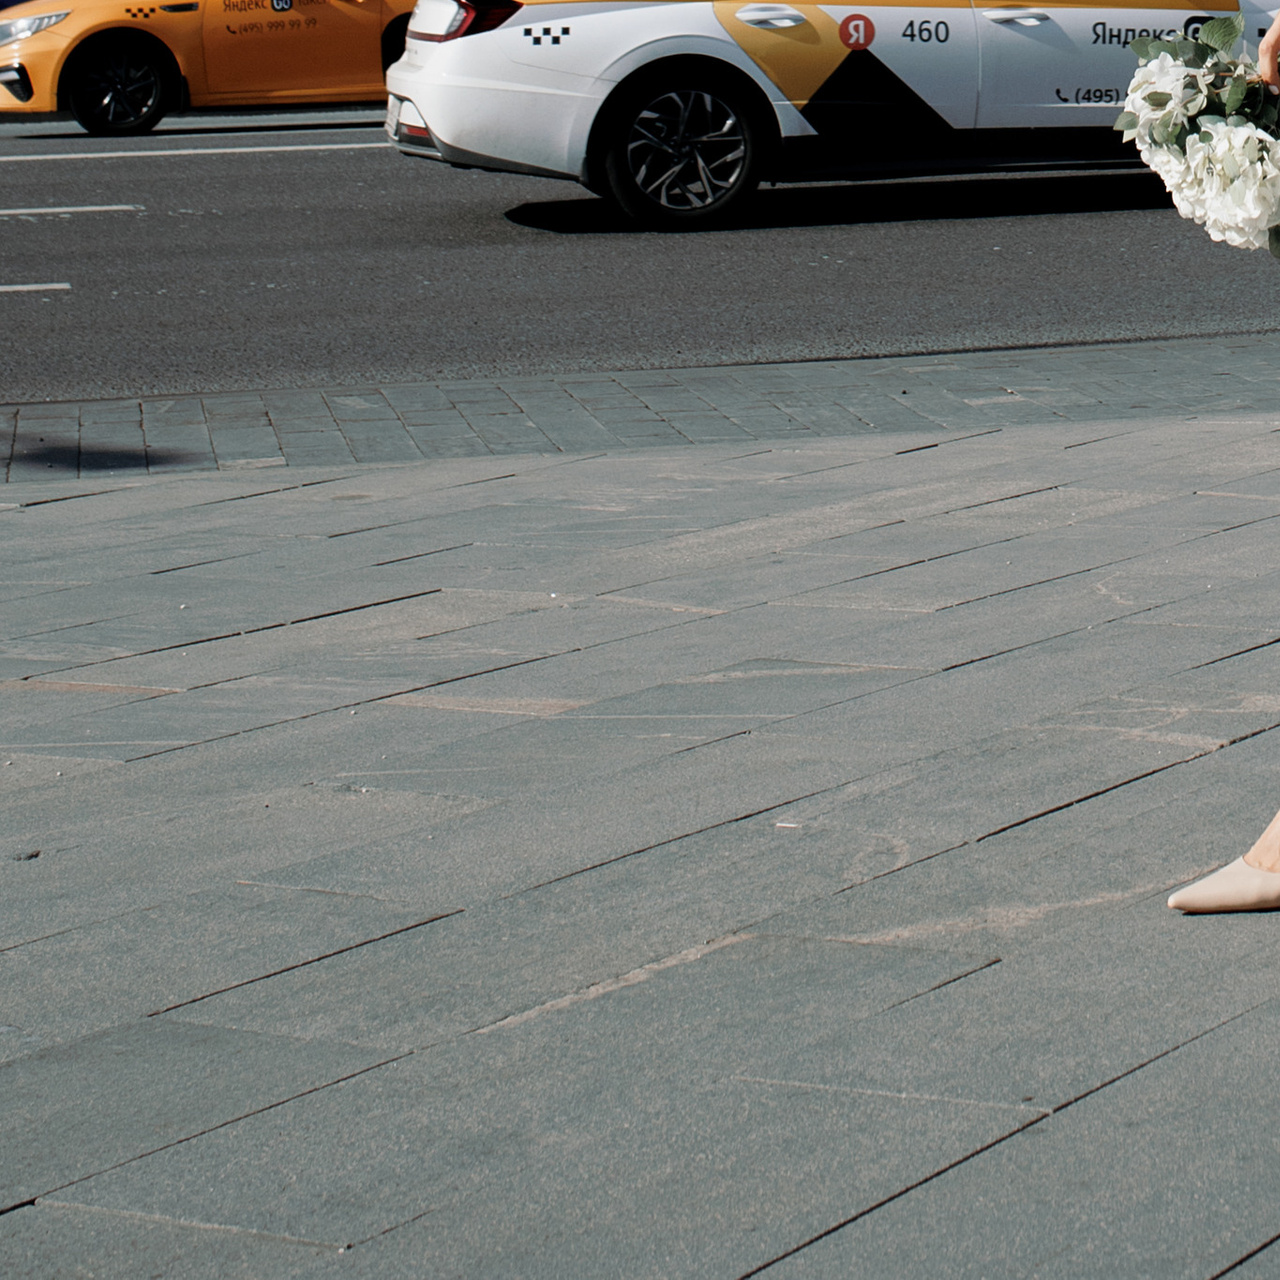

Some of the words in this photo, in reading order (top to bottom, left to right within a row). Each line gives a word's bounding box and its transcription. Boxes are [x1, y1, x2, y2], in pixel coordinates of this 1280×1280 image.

[267, 20, 285, 31] 999
[901, 20, 950, 43] 460
[1075, 88, 1120, 105] (495)
